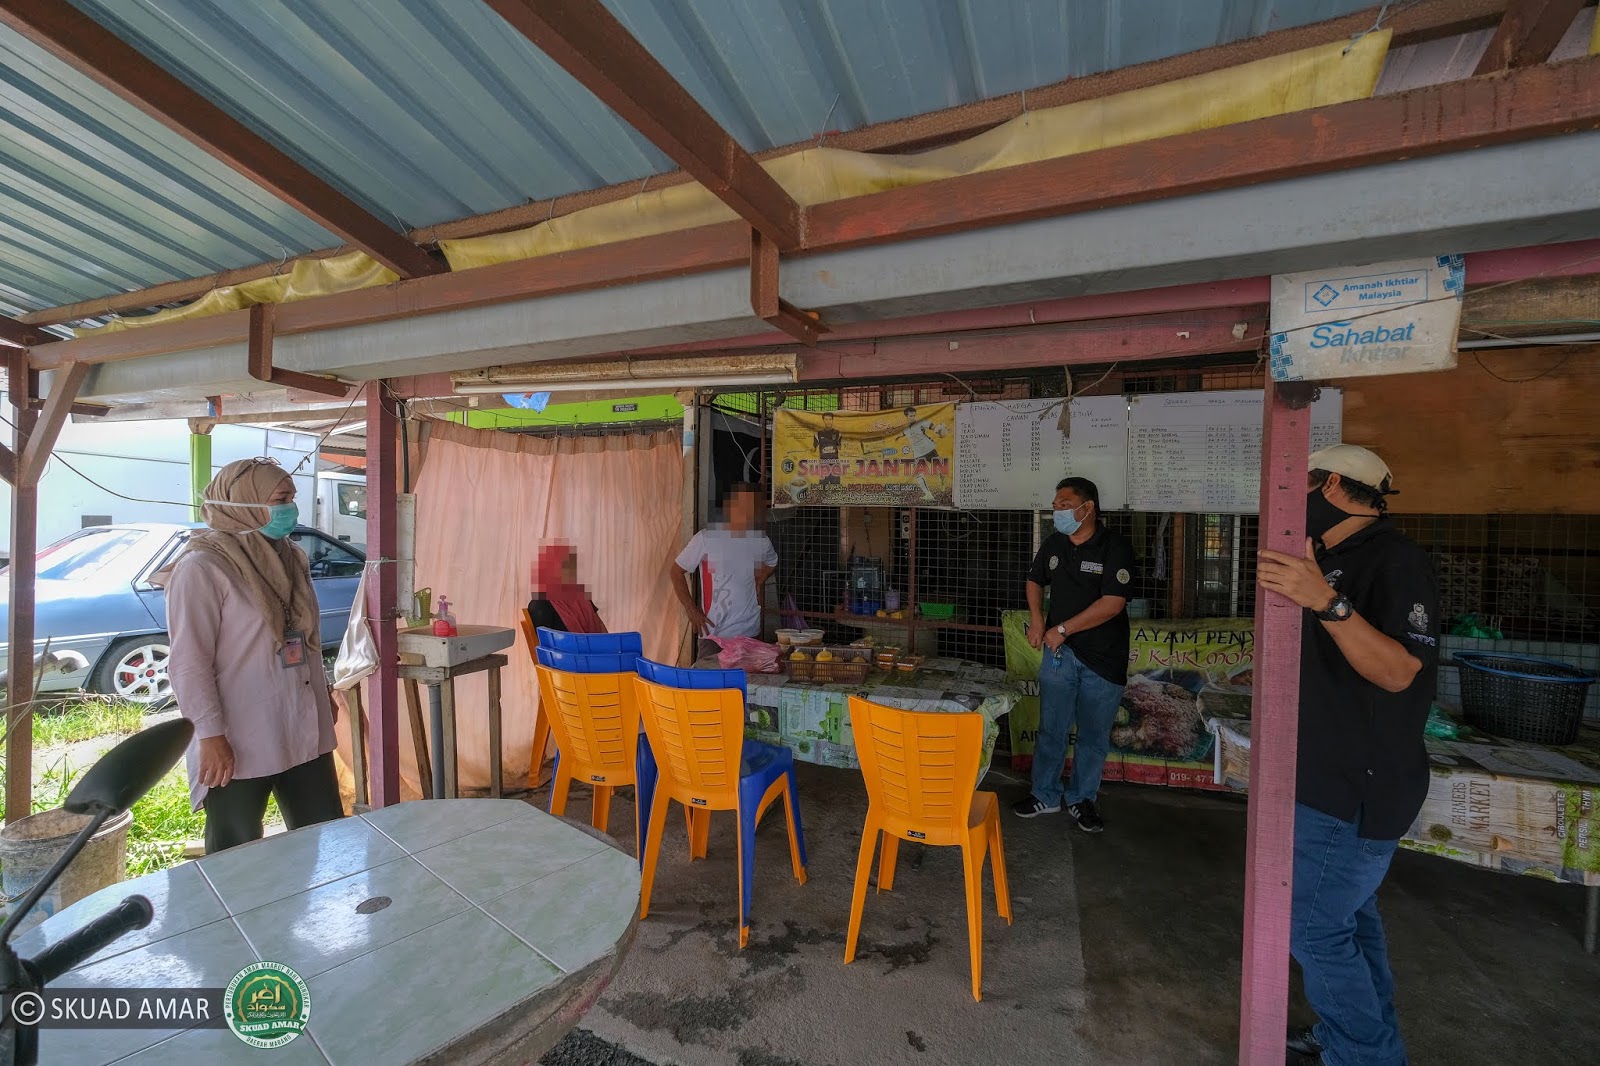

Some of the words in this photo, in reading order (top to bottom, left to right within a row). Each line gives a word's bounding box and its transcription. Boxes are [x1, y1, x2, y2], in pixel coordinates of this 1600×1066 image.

[1343, 281, 1383, 292] Amanah
[1385, 277, 1419, 287] Ikhtiar
[1359, 290, 1401, 301] Malaysia
[1310, 322, 1416, 349] Sahabat
[1006, 413, 1029, 421] CAWAN
[798, 459, 850, 479] Super
[854, 458, 951, 477] JANTAN
[1134, 627, 1198, 644] AYAM
[1451, 782, 1467, 826] FARMERS
[1469, 780, 1490, 832] MARKET
[1556, 792, 1566, 838] CIBOULETTE
[1578, 822, 1589, 849] PERSIL
